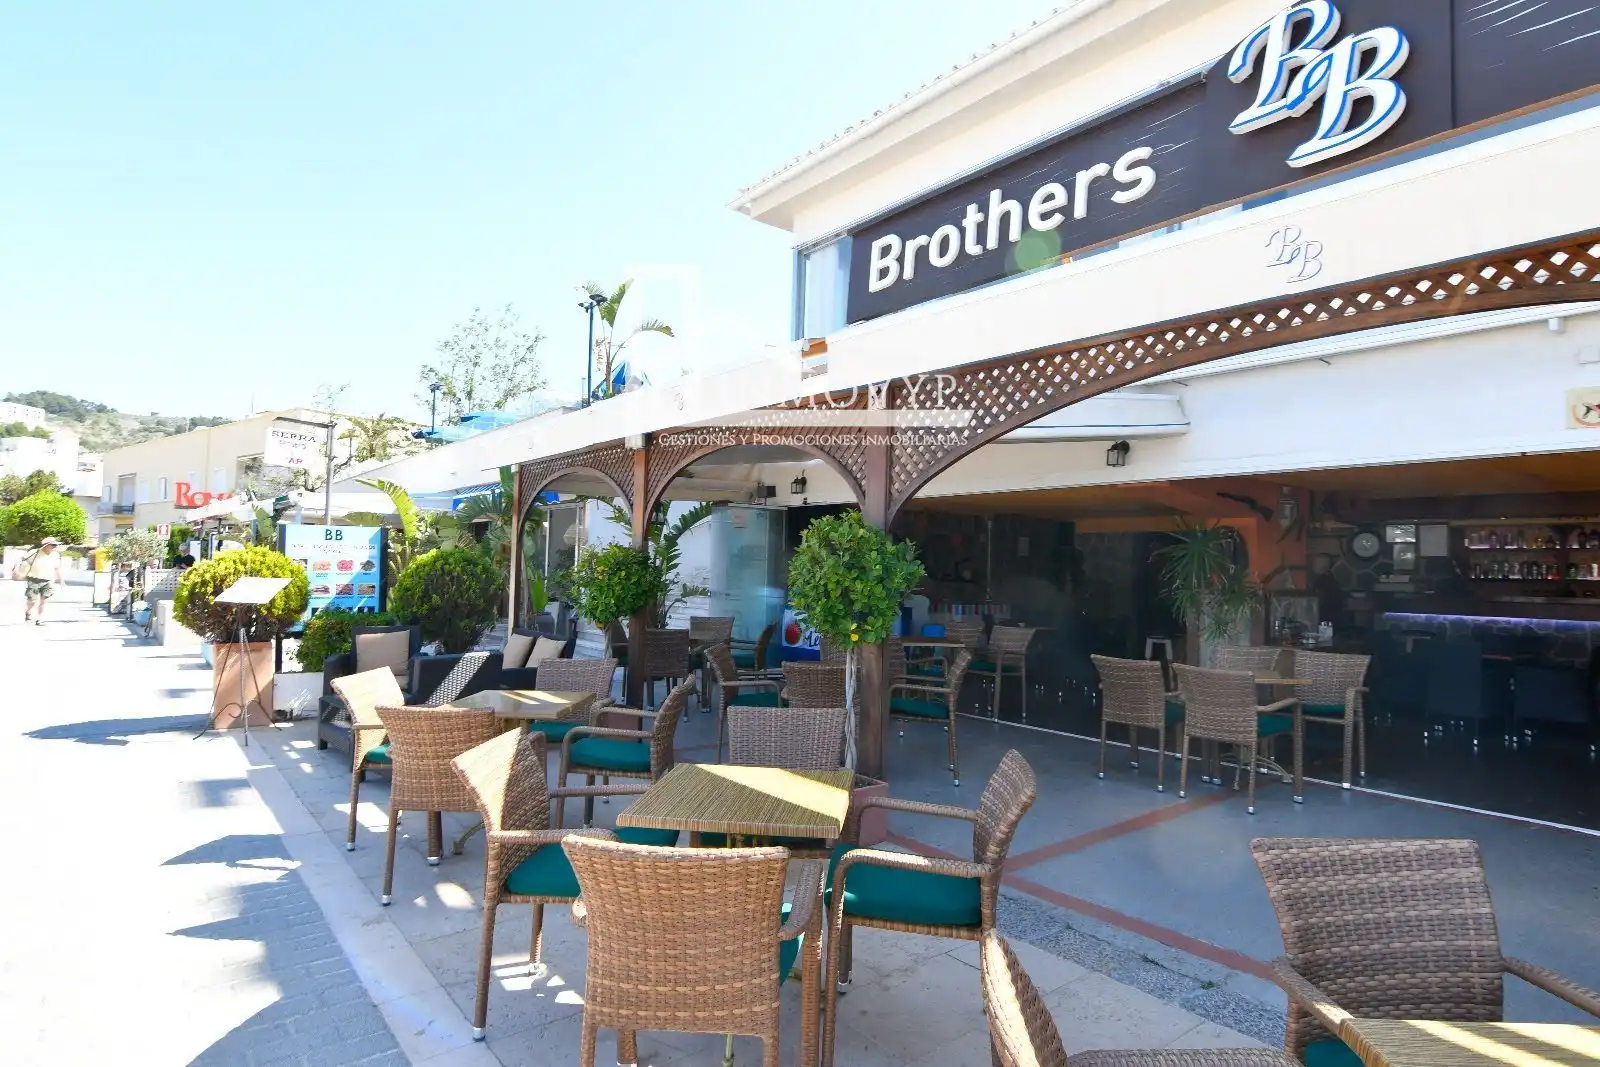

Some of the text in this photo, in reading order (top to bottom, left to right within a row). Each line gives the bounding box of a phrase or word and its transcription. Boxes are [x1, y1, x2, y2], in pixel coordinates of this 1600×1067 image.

[1227, 0, 1410, 168] BB
[868, 146, 1157, 293] Brothers
[271, 430, 316, 443] SERRA
[324, 528, 343, 541] BB
